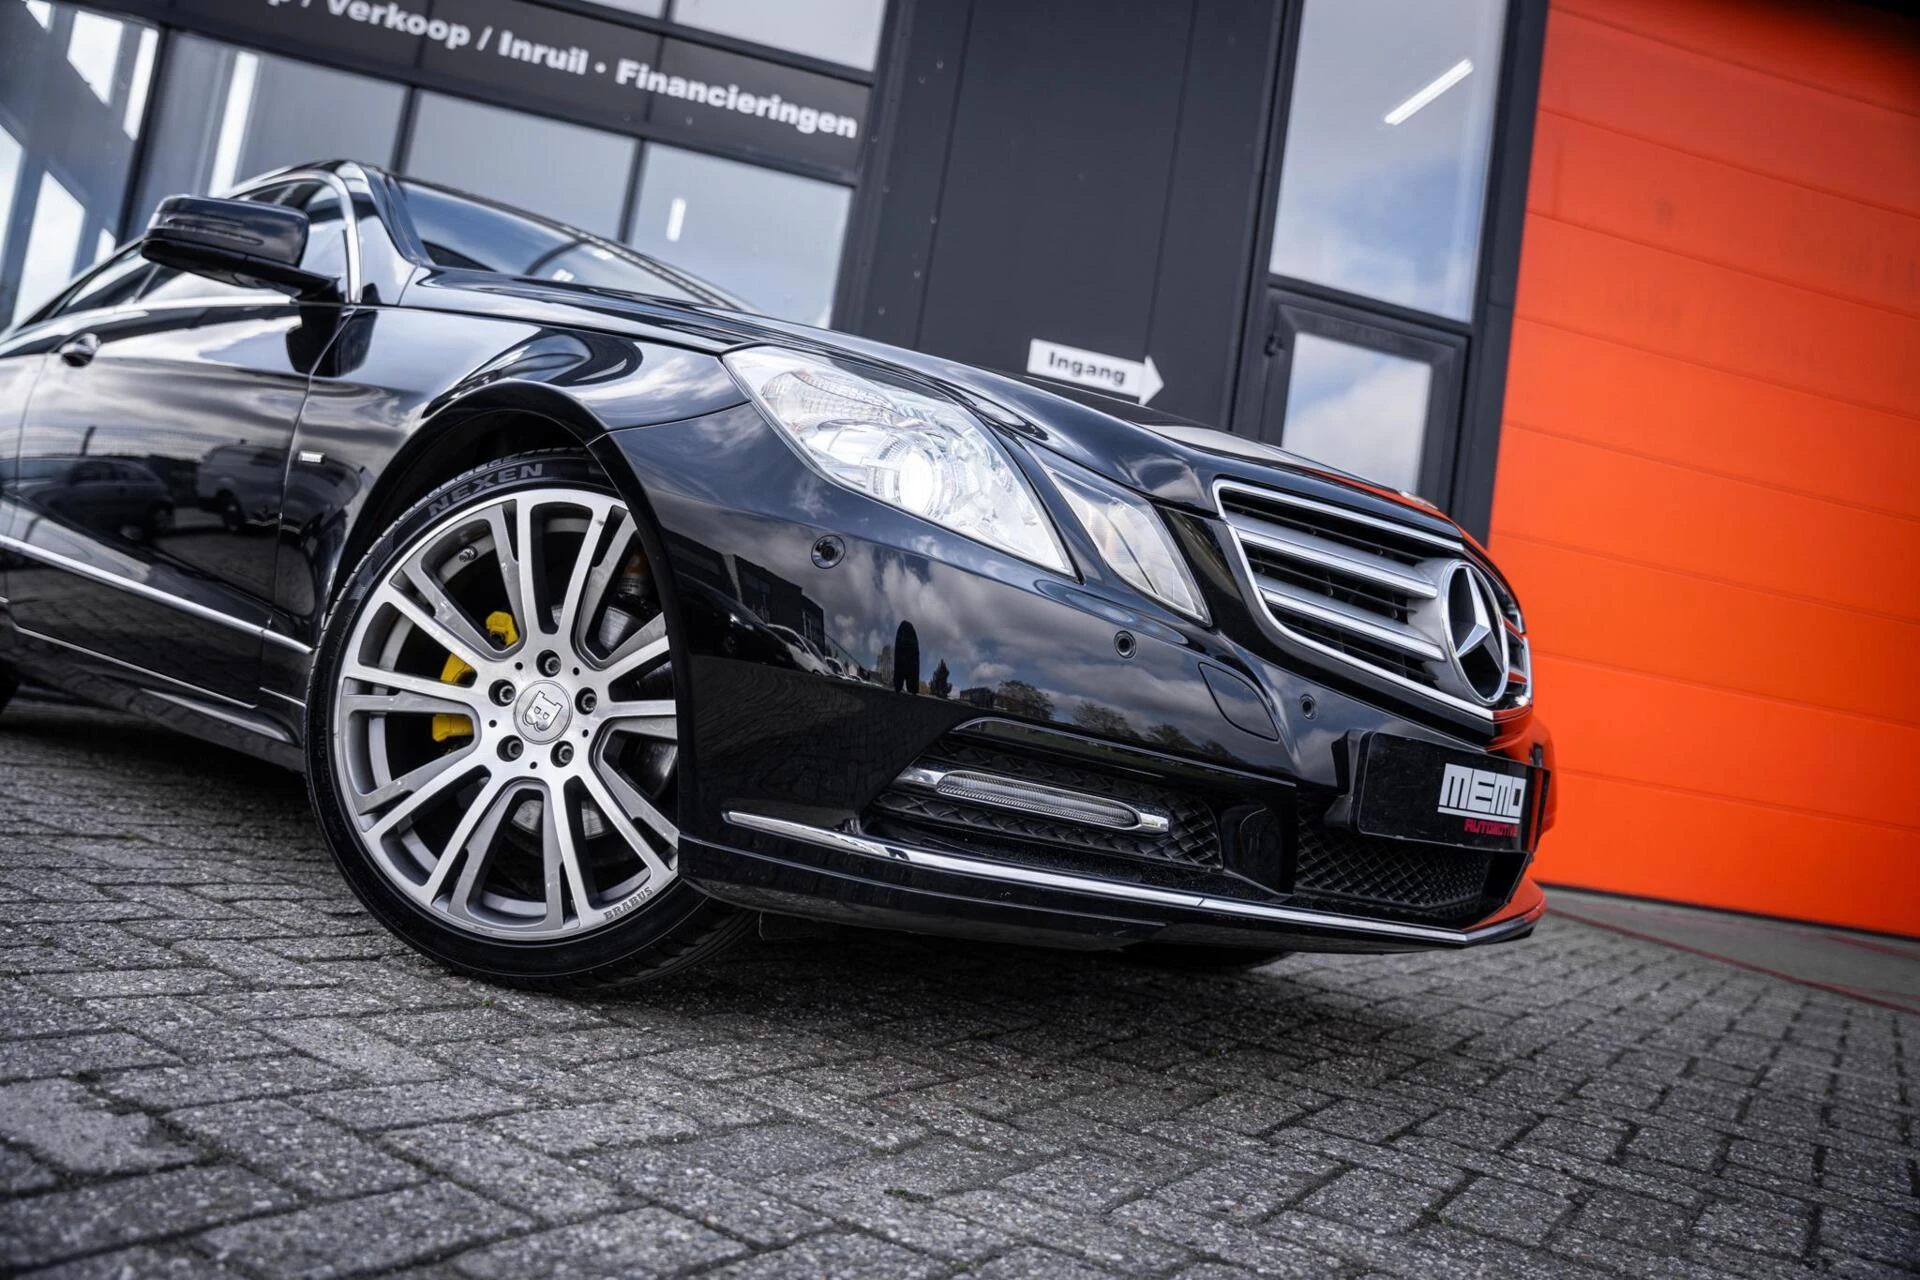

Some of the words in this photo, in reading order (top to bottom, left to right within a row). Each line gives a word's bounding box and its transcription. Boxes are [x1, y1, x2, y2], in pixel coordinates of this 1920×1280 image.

[327, 0, 471, 50] Verkoop
[498, 30, 589, 75] Inruil
[615, 58, 858, 138] Financieringen
[1048, 351, 1126, 386] Ingang
[428, 463, 543, 518] NEXEN
[1439, 763, 1527, 818] MEMO
[603, 886, 654, 921] BRABUS
